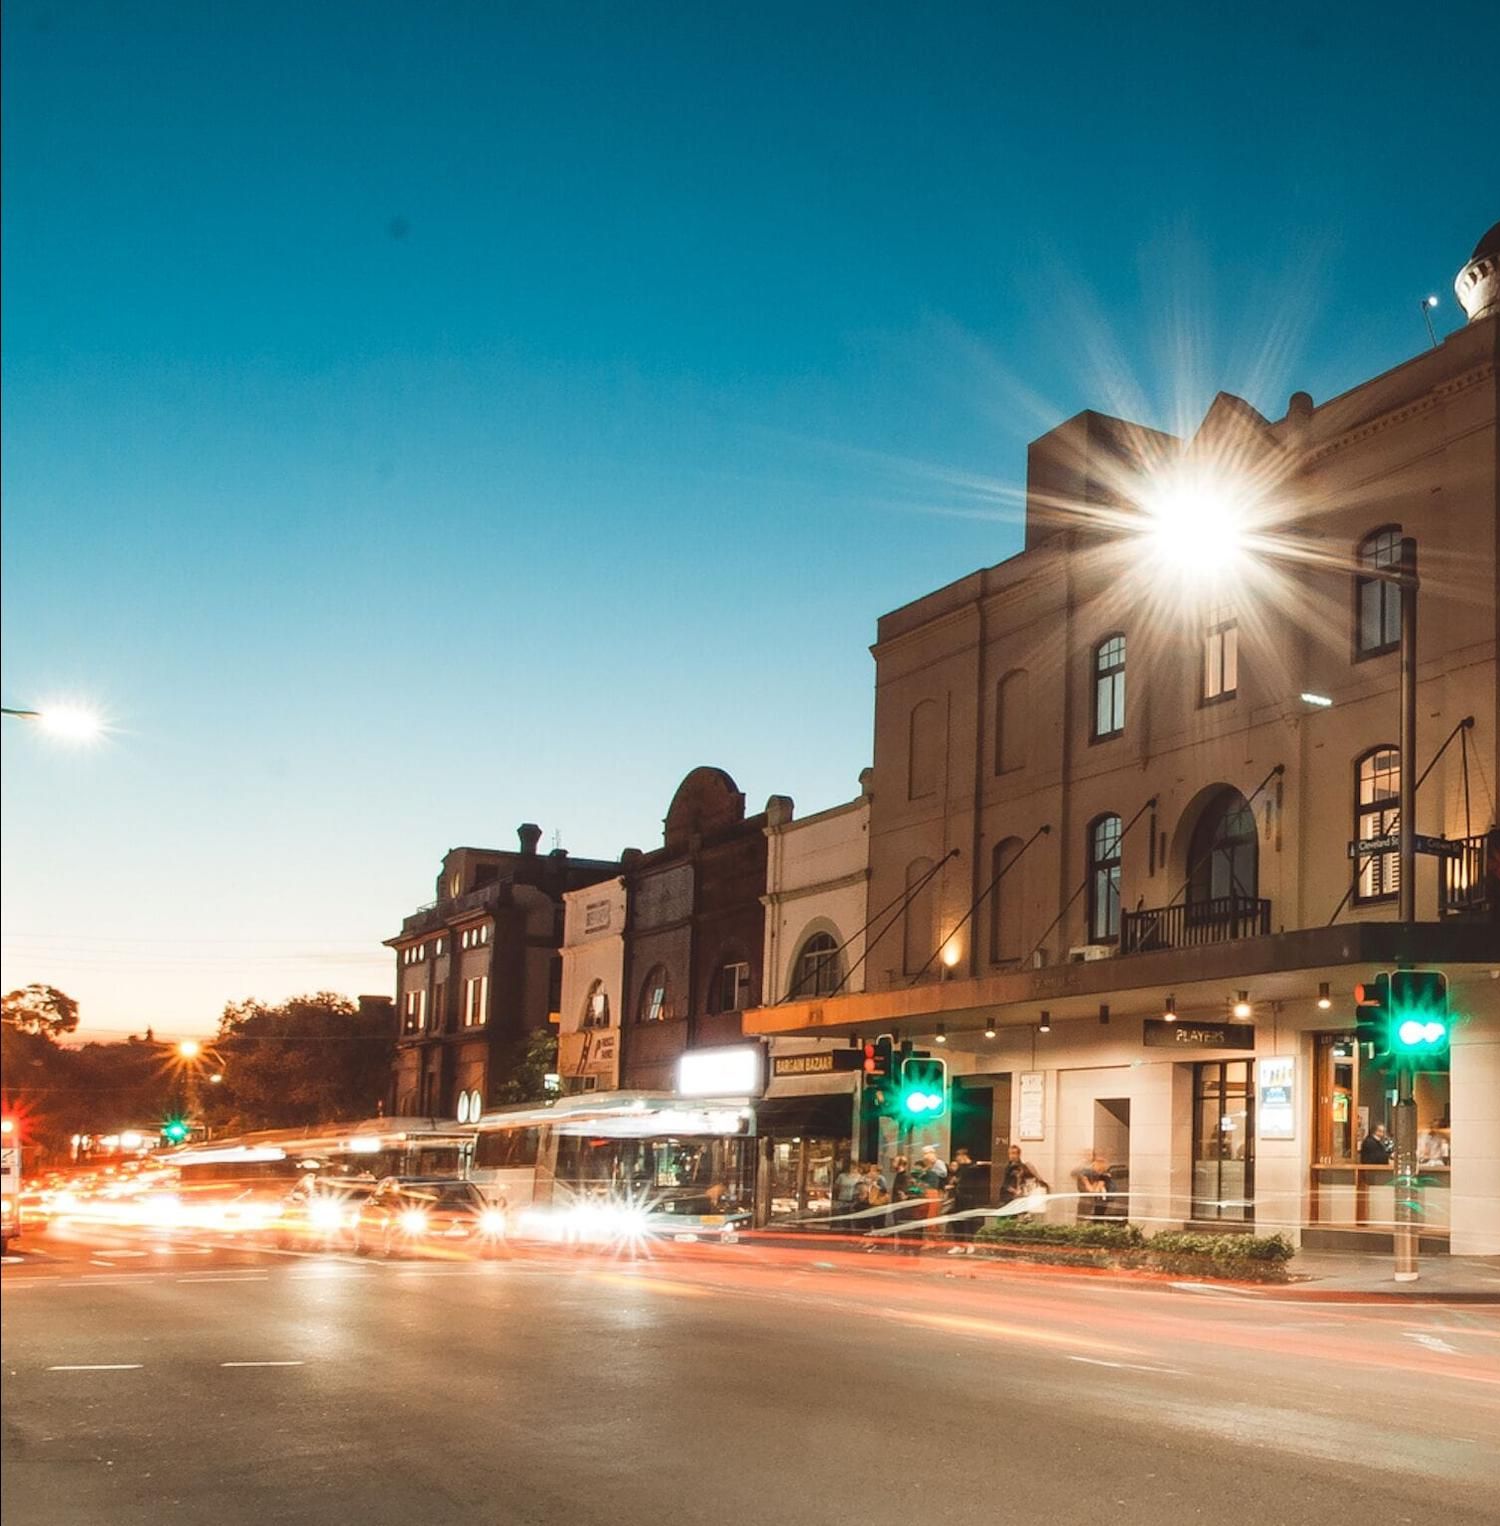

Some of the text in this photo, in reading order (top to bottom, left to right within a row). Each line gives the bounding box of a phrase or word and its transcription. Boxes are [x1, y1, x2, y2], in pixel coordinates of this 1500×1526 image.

[1359, 838, 1390, 851] Cleveland
[1176, 1029, 1224, 1042] PLAYERS
[776, 1058, 804, 1074] BARGAIN
